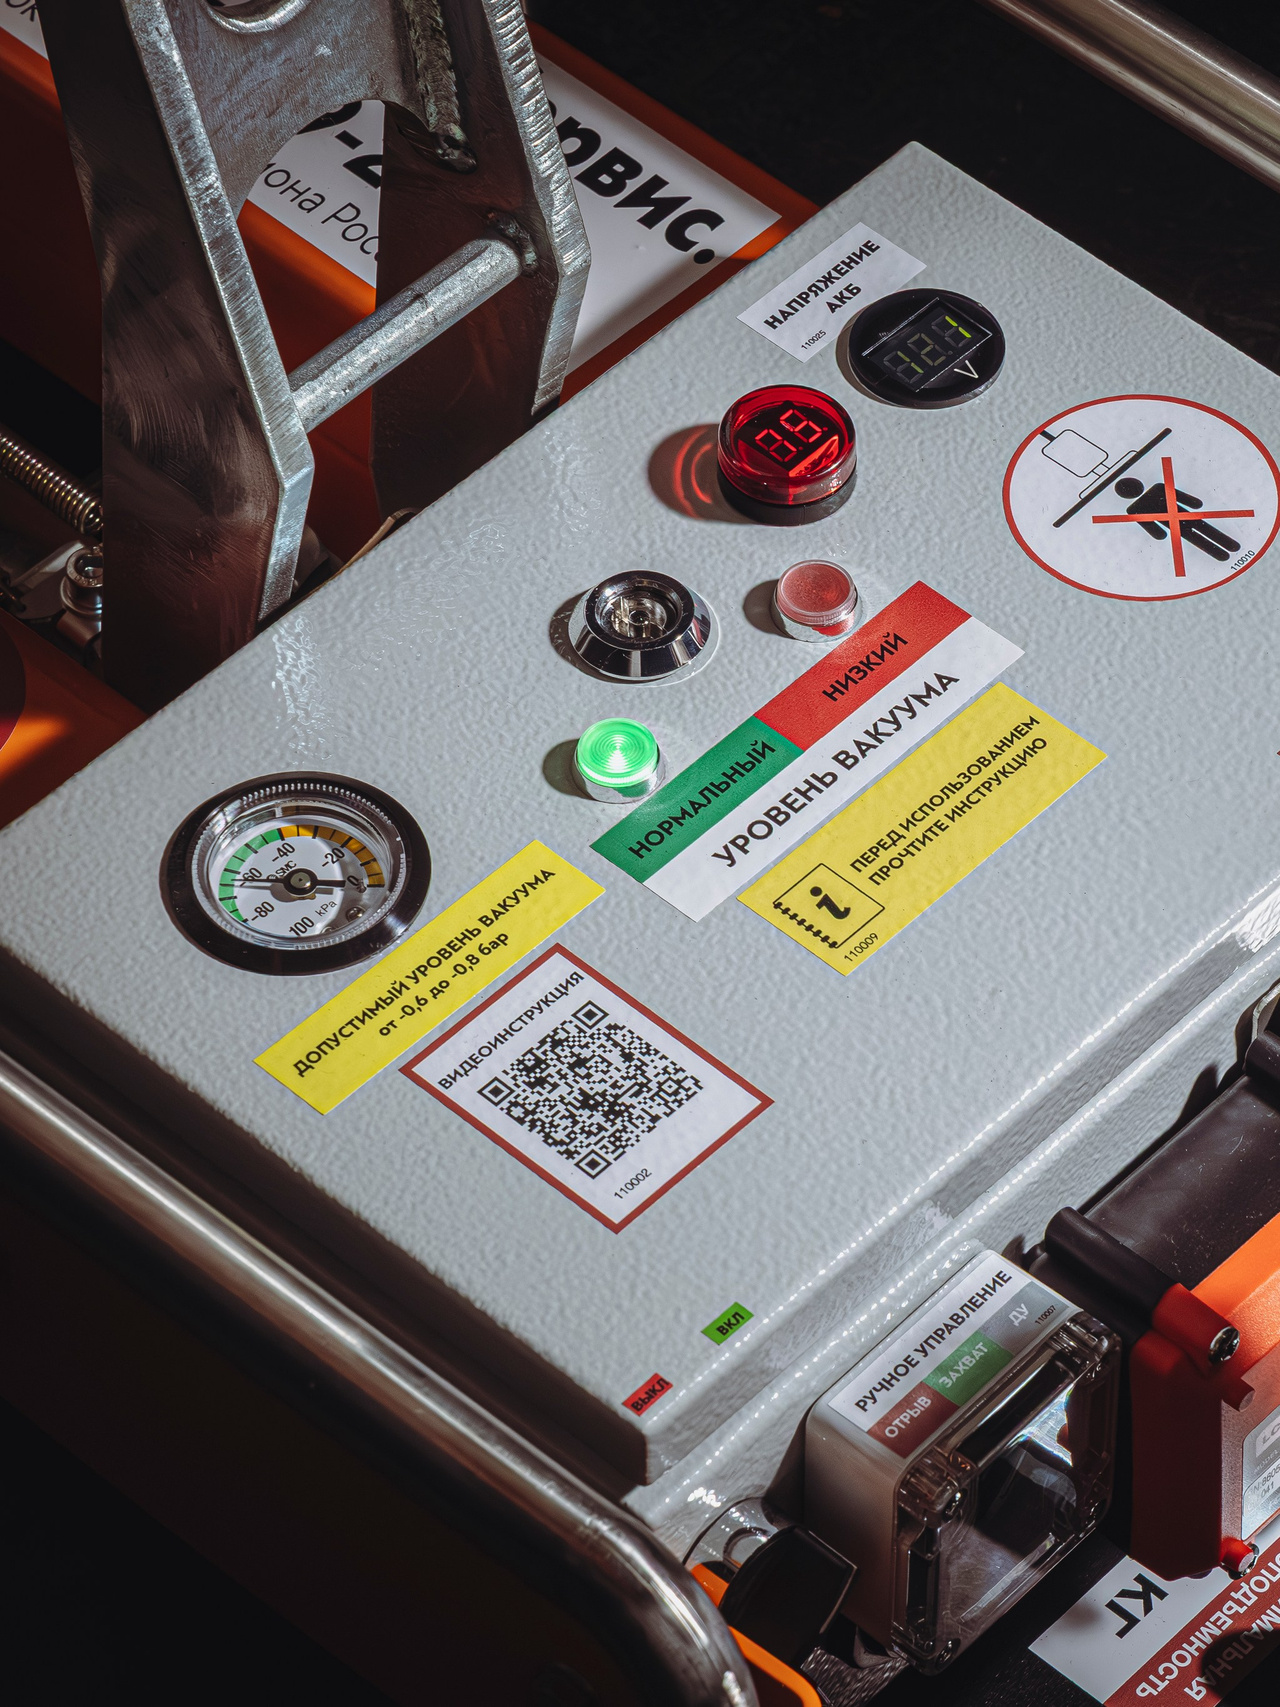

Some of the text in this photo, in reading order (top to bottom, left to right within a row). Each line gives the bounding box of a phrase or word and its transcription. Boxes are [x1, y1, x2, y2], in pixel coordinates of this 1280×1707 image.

[763, 239, 881, 330] НАПРЯЖЕНИЕ
[825, 282, 862, 314] АКБ
[800, 330, 827, 351] 110025
[953, 359, 979, 379] V
[821, 630, 909, 703] НИЗКИЙ
[628, 738, 777, 860] НОРМАЛЬНЫЙ
[711, 672, 960, 869] УРОВЕНЬ ВАКУУМА
[850, 715, 1041, 874] ПЕРЕД ИСПОЛЬЗОВАНИЕМ
[868, 737, 1048, 886] ПРОЧТИТЕ ИНСТРУКЦИЮ
[315, 900, 337, 917] kPa
[293, 868, 556, 1078] ДОПУСТИМЫЙ УРОВЕНЬ ВАКУУМА
[843, 932, 879, 963] 110009
[379, 930, 510, 1037] от -0,6 до -0,8 бар
[437, 971, 585, 1090] ВИДЕОИНСТРУКЦИЯ
[613, 1168, 652, 1201] 110002
[716, 1311, 745, 1336] ВКЛ
[854, 1269, 1013, 1413] РУЧНОЕ УПРАВЛЕНИЕ
[1008, 1302, 1030, 1327] ДУ
[938, 1341, 990, 1389] ЗАХВАТ
[630, 1377, 671, 1412] ВЫКЛ
[884, 1395, 932, 1439] ОТРЫВ
[1104, 1572, 1169, 1640] КГ
